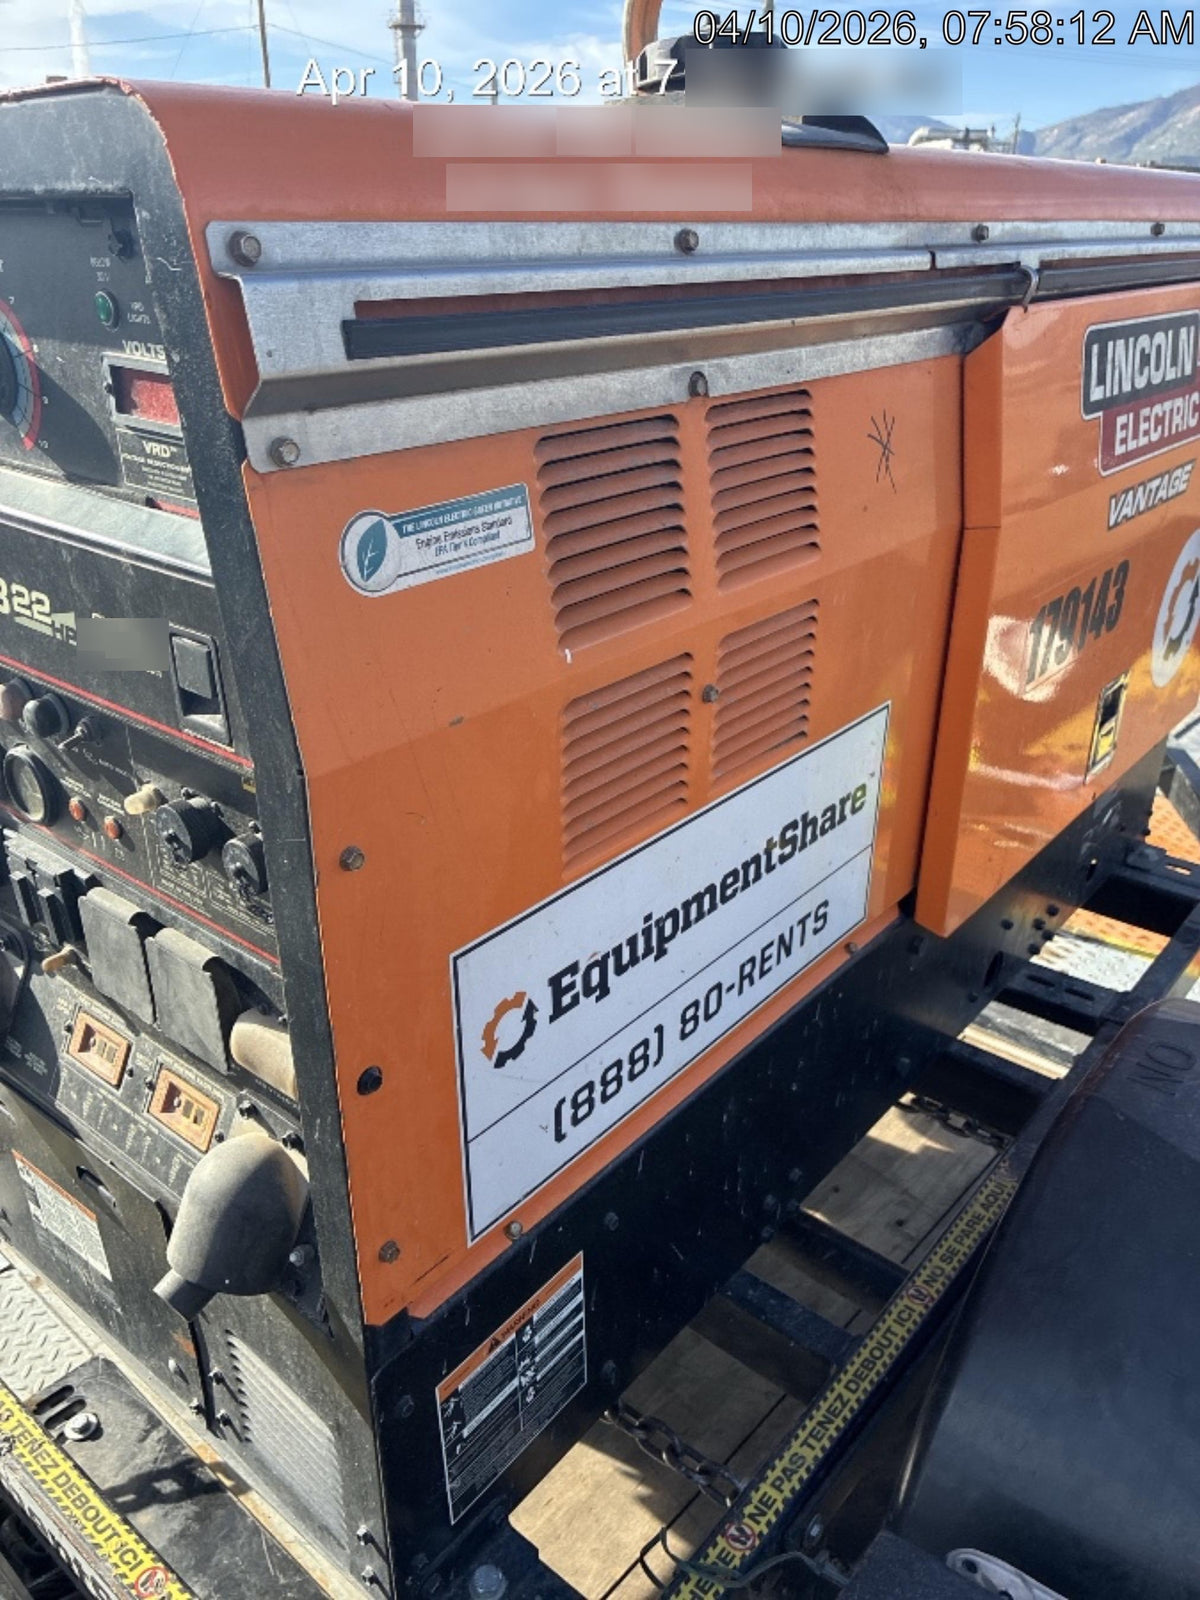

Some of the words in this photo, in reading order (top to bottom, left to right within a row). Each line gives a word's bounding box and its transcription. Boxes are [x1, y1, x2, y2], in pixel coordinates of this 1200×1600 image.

[122, 339, 167, 361] VOLTS
[1089, 324, 1196, 403] LINCOLN
[1114, 391, 1200, 457] ELECTRIC
[1107, 460, 1196, 531] VANTAGE
[1025, 559, 1131, 685] 179143
[547, 782, 868, 1025] EquipmentShare
[553, 1023, 665, 1143] (888)
[678, 898, 831, 1042] 80-RENTS
[939, 1246, 961, 1266] SE
[954, 1211, 986, 1247] PARE
[747, 1491, 778, 1526] NE
[770, 1451, 807, 1494] PAS
[799, 1393, 850, 1452] TENEZ
[843, 1329, 900, 1395] DEBOUT
[892, 1304, 917, 1329] ICI
[52, 1470, 121, 1543] DEBOUT
